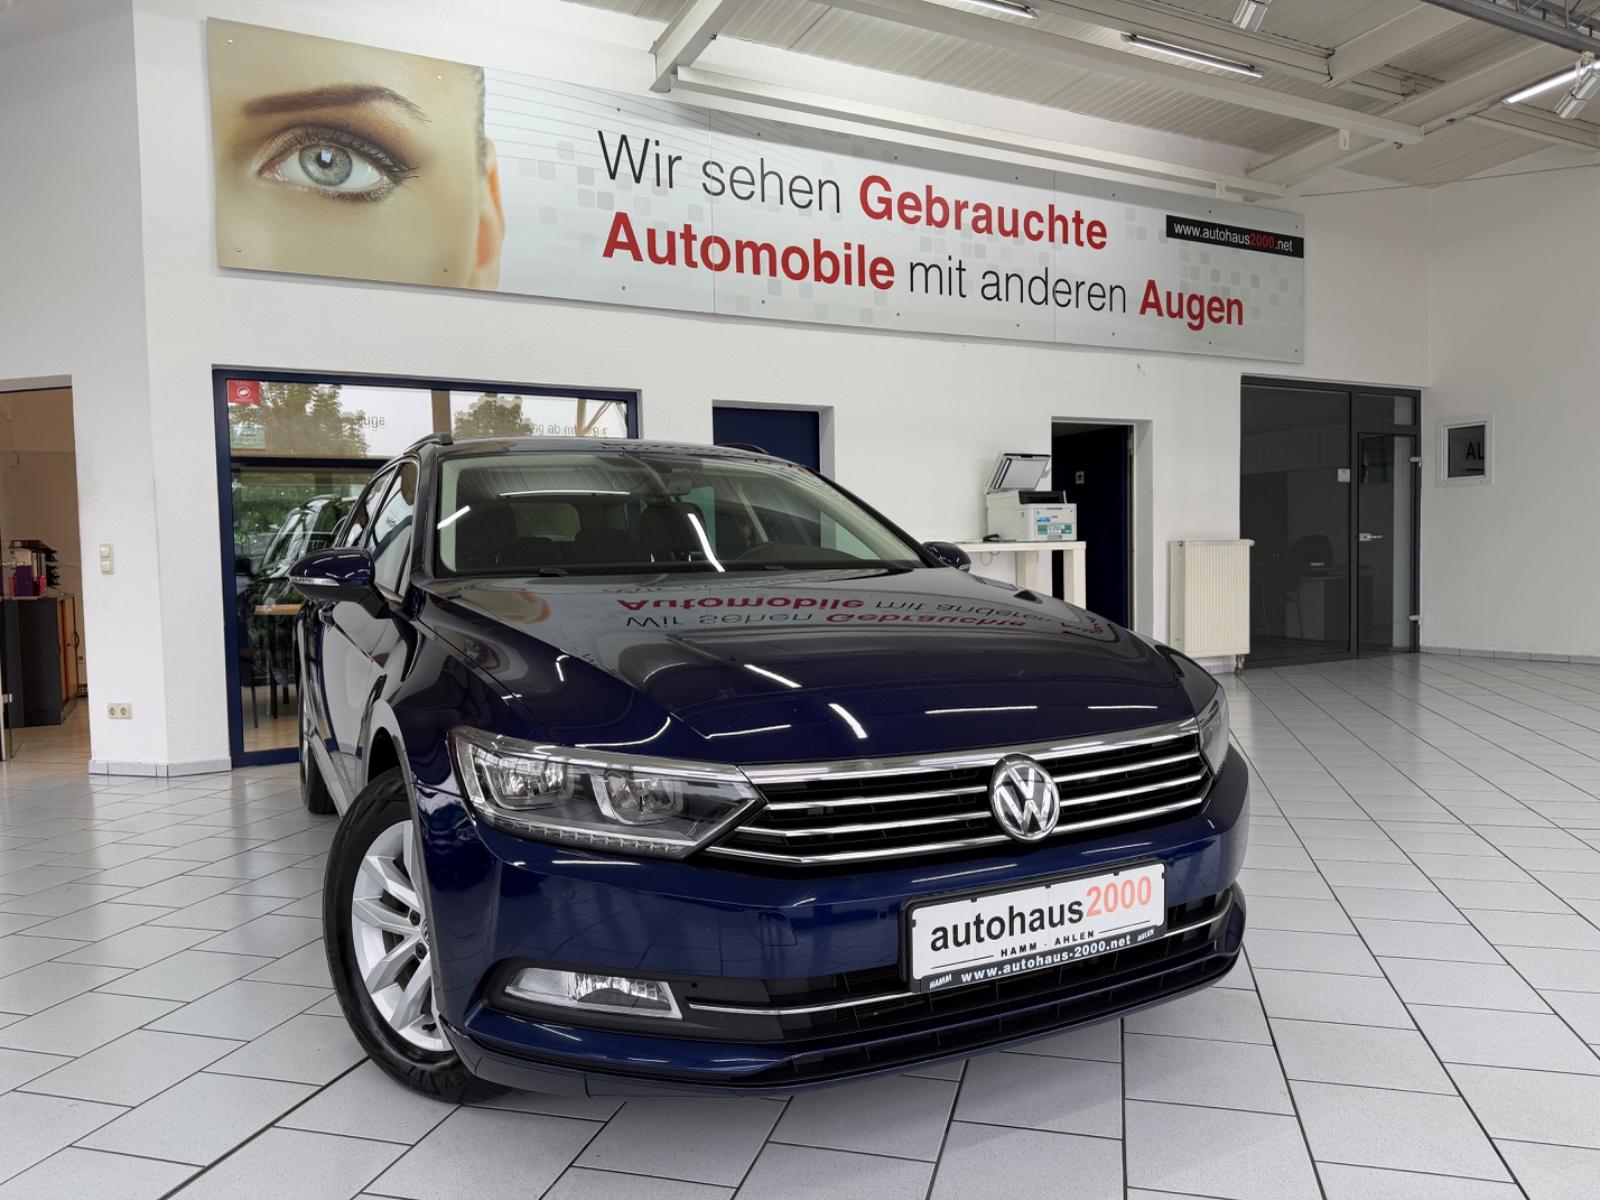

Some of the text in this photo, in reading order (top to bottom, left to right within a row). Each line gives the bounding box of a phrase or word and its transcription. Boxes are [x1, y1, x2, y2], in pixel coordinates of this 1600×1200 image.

[598, 129, 1108, 250] Wir sehen Gebrauchte
[1173, 222, 1294, 252] www.autohaus2000.net
[602, 211, 1245, 331] Automobile mit anderen Augen
[929, 875, 1152, 952] autohaus2000
[1000, 942, 1038, 958] HAMM
[1054, 930, 1096, 946] AHLEN
[960, 934, 1132, 984] www.autohaus-2000.net
